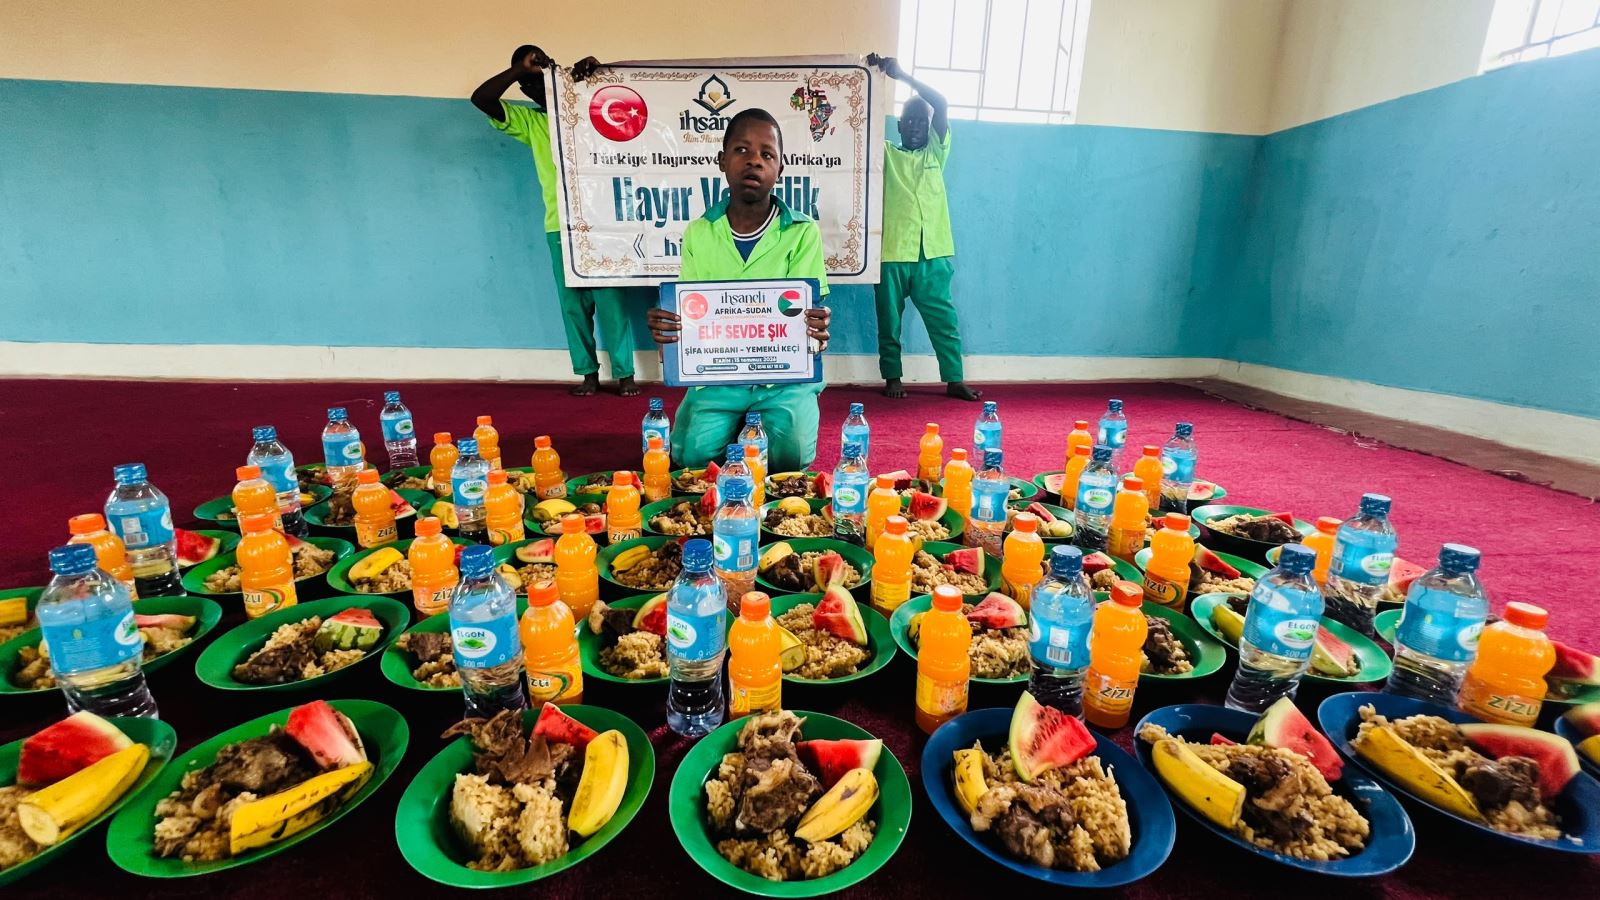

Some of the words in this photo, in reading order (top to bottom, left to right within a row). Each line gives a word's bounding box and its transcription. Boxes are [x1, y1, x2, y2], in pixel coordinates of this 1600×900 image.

[590, 152, 647, 167] Türkiye
[652, 152, 720, 168] Hayırseve
[782, 153, 842, 168] Afrika'ya
[612, 176, 692, 228] Hayır
[698, 322, 722, 340] ELİF
[725, 324, 765, 339] SEVDE
[768, 323, 788, 342] ŞIK
[704, 346, 738, 354] KURBANI
[746, 344, 780, 353] YEMEKLİ
